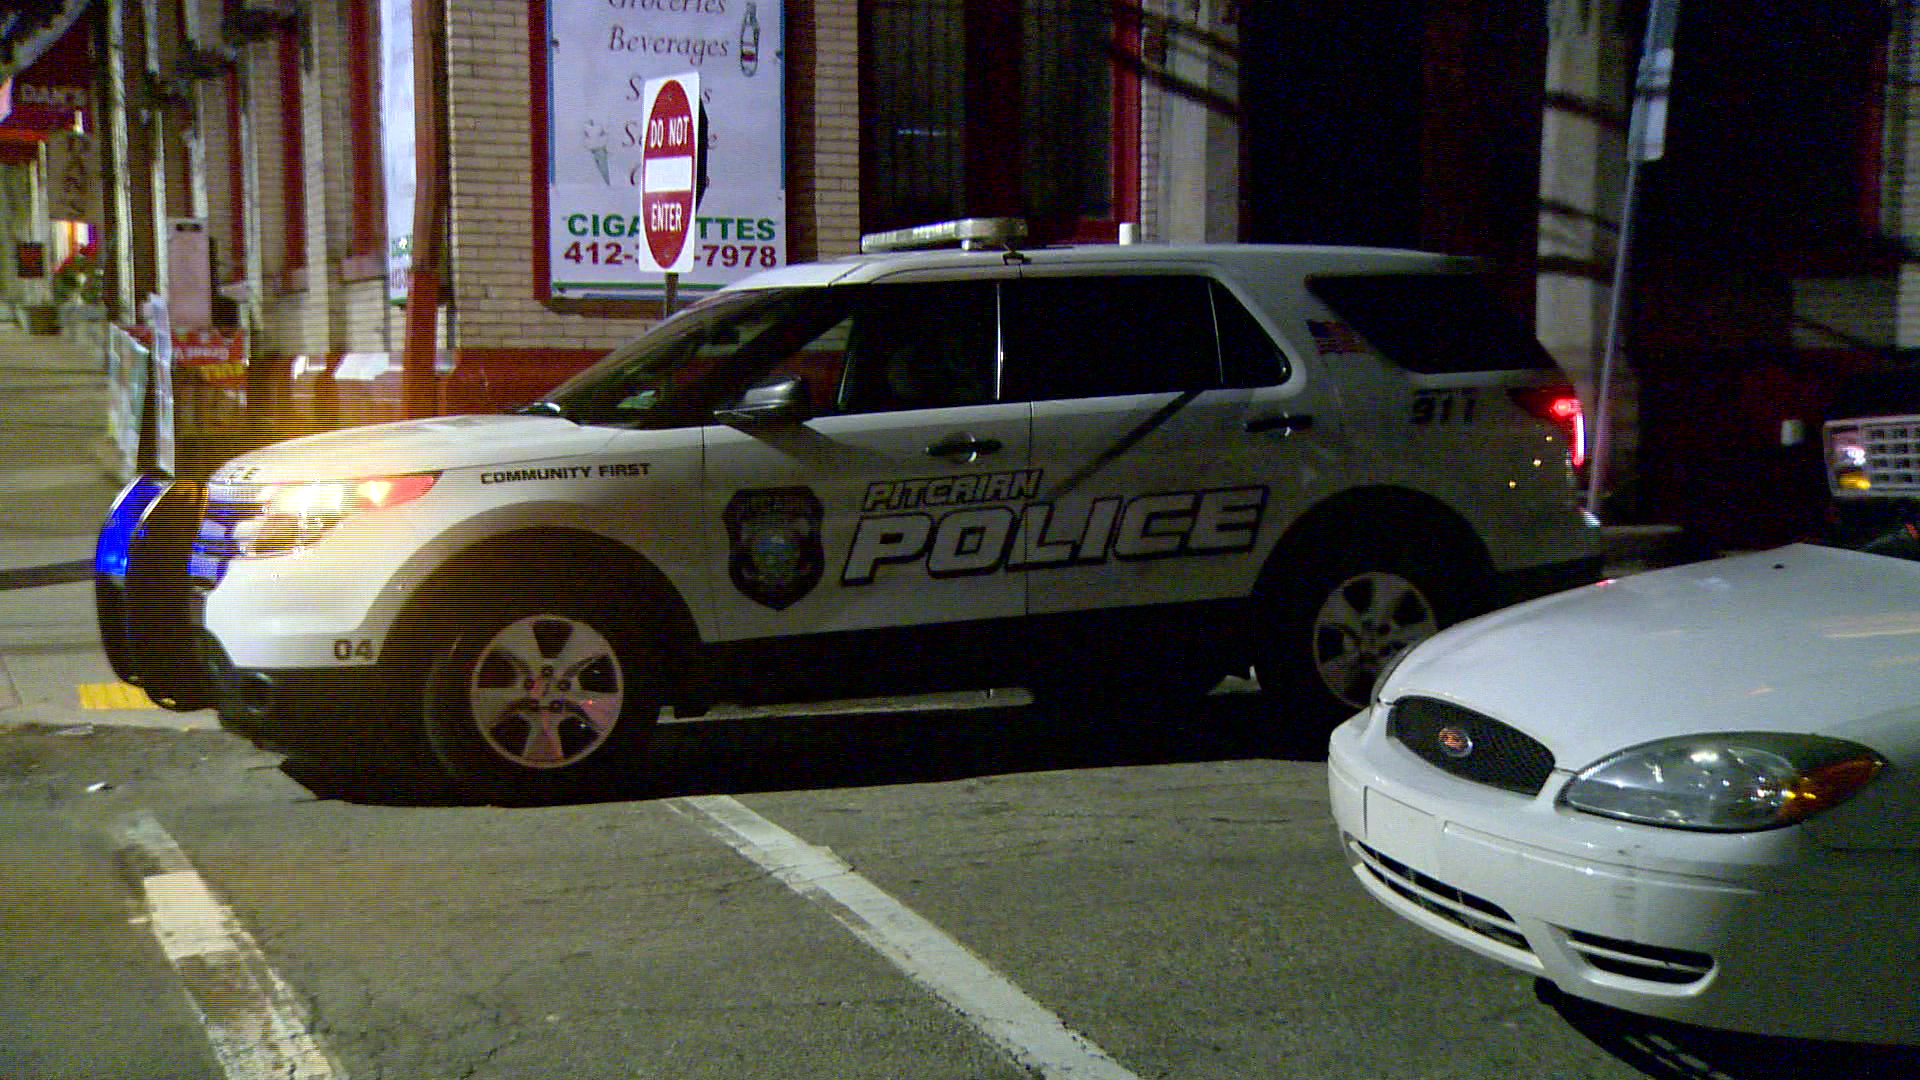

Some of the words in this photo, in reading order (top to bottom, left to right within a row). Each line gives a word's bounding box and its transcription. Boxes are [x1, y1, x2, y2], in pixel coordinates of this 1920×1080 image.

[609, 24, 729, 66] Beverages
[650, 118, 664, 149] DO
[669, 116, 690, 147] NOT
[651, 203, 682, 233] ENTER
[1410, 387, 1479, 425] 911
[480, 466, 592, 485] COMMUNITY
[598, 462, 651, 478] FIRST
[841, 485, 1269, 586] POLICE
[334, 638, 373, 661] 04
